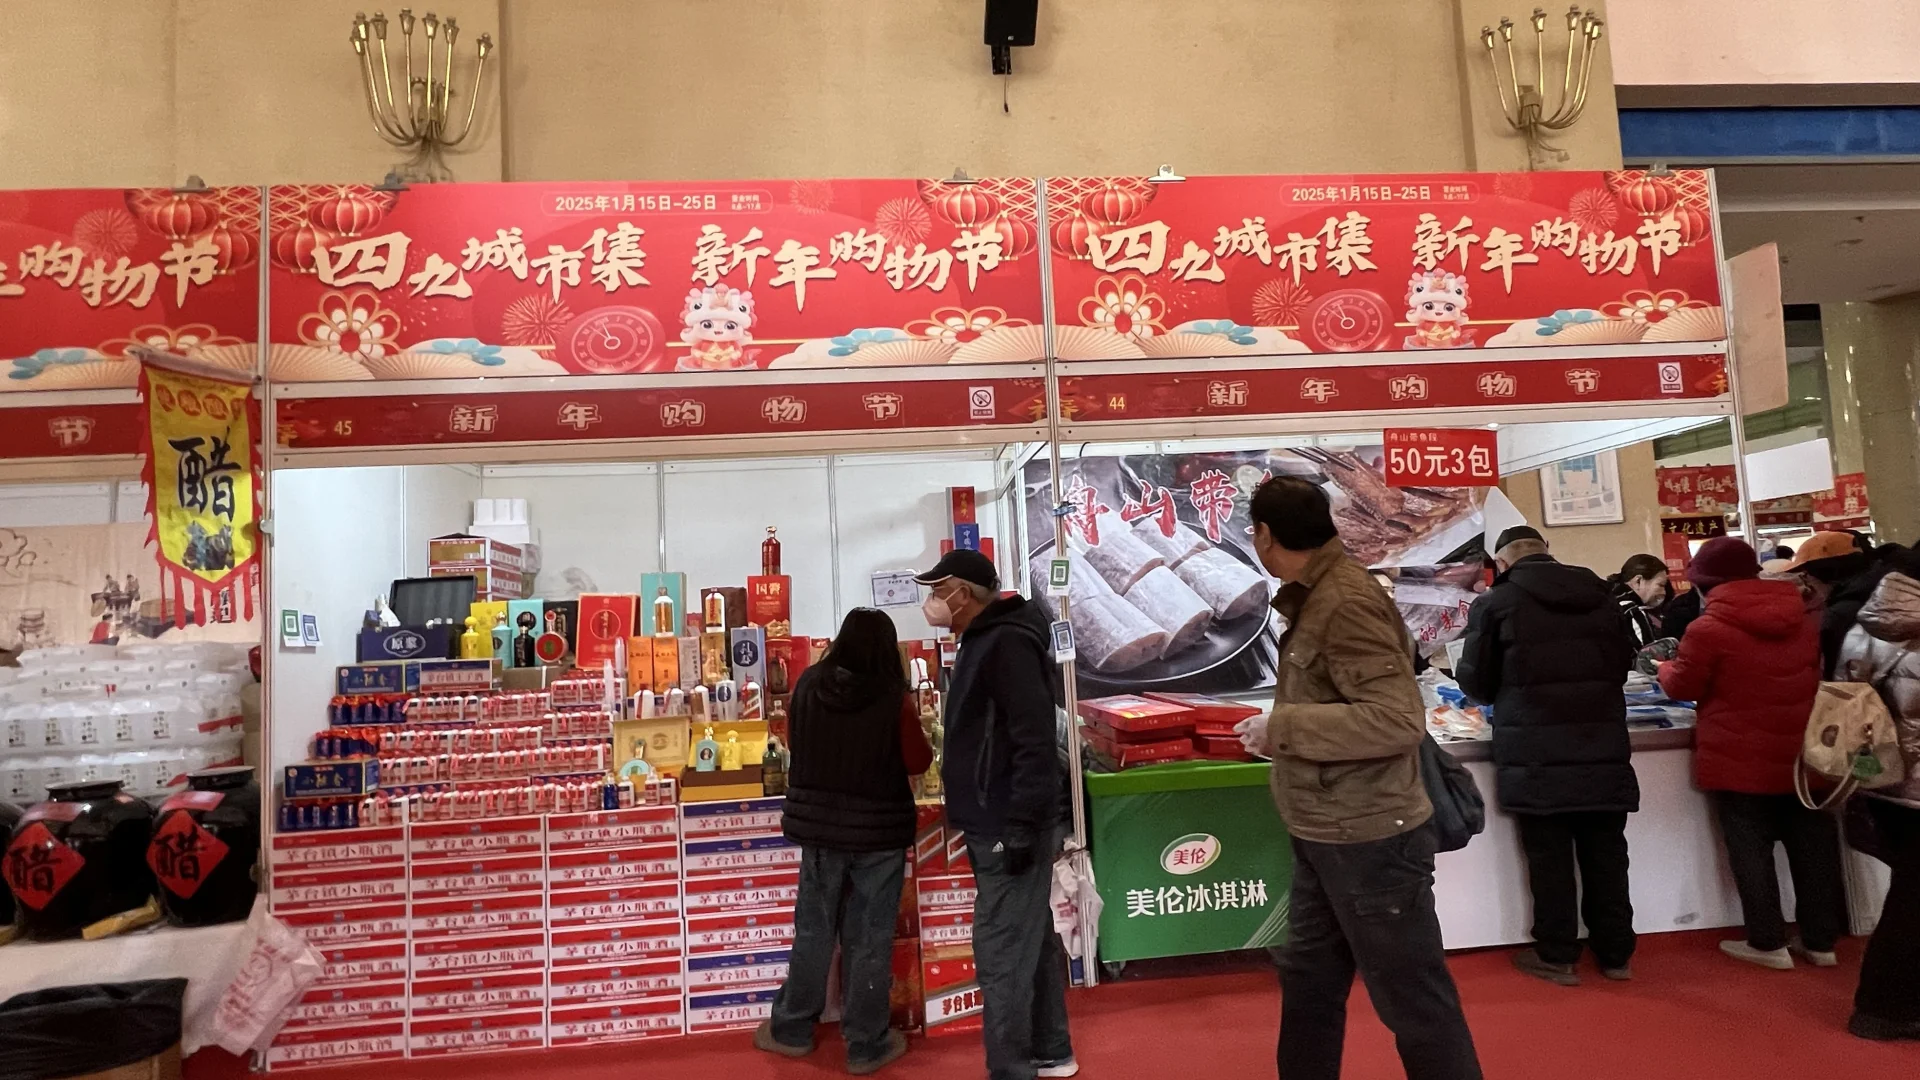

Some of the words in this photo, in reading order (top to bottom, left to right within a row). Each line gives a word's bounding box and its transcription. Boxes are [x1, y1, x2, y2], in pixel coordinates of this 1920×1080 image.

[556, 194, 717, 212] 2025年1月15日-25日
[1292, 185, 1431, 202] 2025年1月15日-25日
[1084, 210, 1378, 288] 四九城市集
[1411, 212, 1683, 295] 新年购物节
[310, 221, 651, 304] 四九城市集
[691, 223, 1006, 313] 新年购物节
[1108, 396, 1126, 411] 44
[49, 416, 95, 448] 节
[333, 420, 352, 436] 45
[1390, 444, 1493, 478] 50元3包
[168, 425, 242, 523] 醋
[699, 813, 779, 829] 茅台镇王子
[155, 824, 207, 882] 醋
[1173, 847, 1207, 866] 美伦
[9, 844, 63, 892] 醋
[927, 891, 976, 903] 茅台镇小瓶
[1126, 879, 1269, 918] 美伦冰淇淋
[323, 960, 393, 977] 镇小瓶酒
[704, 965, 785, 982] 茅台镇王子
